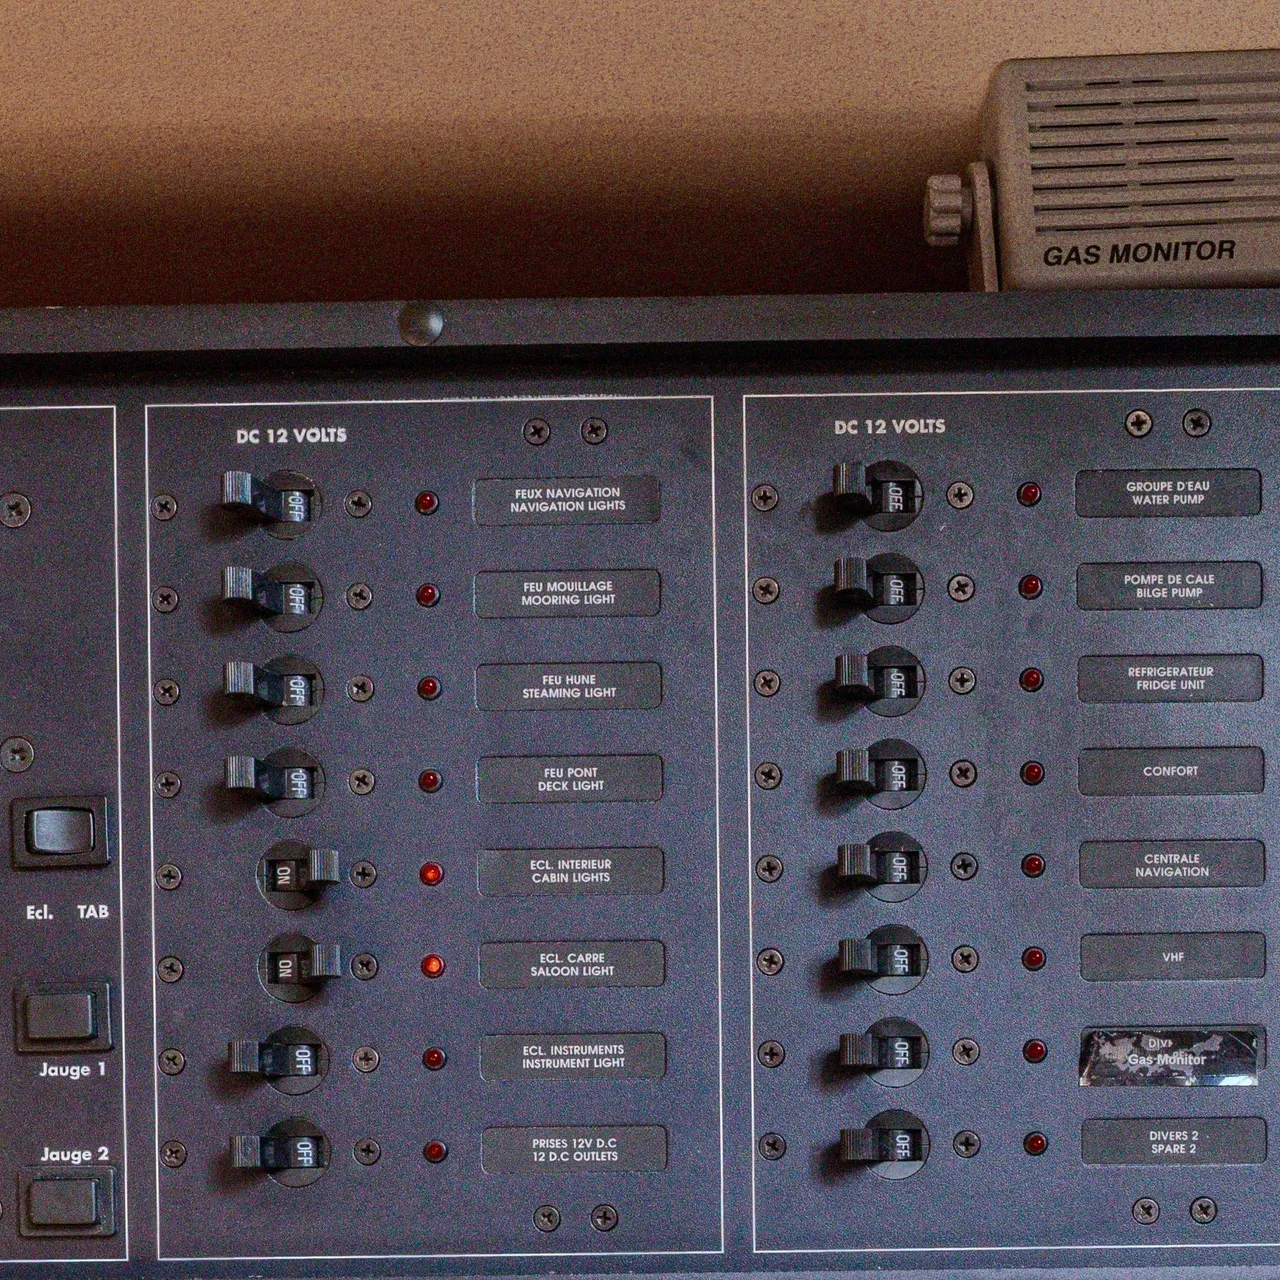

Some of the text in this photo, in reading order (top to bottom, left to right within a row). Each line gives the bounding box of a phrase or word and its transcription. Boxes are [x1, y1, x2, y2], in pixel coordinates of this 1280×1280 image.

[1043, 239, 1236, 267] GAS MONITOR
[835, 419, 946, 434] DC 12 VOLTS
[237, 428, 346, 444] DC 12 VOLTS
[1127, 481, 1210, 492] GROUPE D'EAU
[515, 487, 620, 499] FEUX NAVIGATION
[889, 488, 903, 510] OFF
[1133, 494, 1204, 504] WATER PUMP
[511, 500, 625, 512] NAVIGATION LIGHTS
[1125, 574, 1214, 585] POMPE DE CALE
[524, 581, 612, 592] FEU MOUILLAGE
[1137, 587, 1202, 598] BILGE PUMP
[290, 588, 304, 611] OFF
[522, 593, 615, 605] MOORING LIGHT
[1129, 667, 1213, 677] REFRIGERATEUR
[543, 675, 595, 685] FEU HUNE
[1137, 679, 1205, 690] FRIDGE UNIT
[523, 687, 616, 699] STEAMING LIGHT
[544, 768, 597, 778] FEU PONT
[892, 765, 905, 788] OFF
[1144, 766, 1198, 776] CONFORT
[539, 780, 604, 791] DECK LIGHT
[1145, 854, 1199, 864] CENTRALE
[277, 867, 291, 885] ON
[532, 872, 610, 883] CABIN LIGHTS
[1136, 867, 1209, 877] NAVIGATION
[27, 906, 53, 919] Ecl.
[78, 905, 109, 918] TAB
[895, 949, 908, 973] OFF
[1163, 952, 1184, 962] VHF
[279, 960, 292, 977] ON
[531, 966, 614, 976] SALOON LIGHT
[523, 1058, 624, 1068] INSTRUMENT LIGHT
[1158, 1054, 1206, 1065] Monitor
[40, 1062, 106, 1080] Jauge 1
[896, 1134, 909, 1158] OFF
[42, 1146, 109, 1164] Jauge 2
